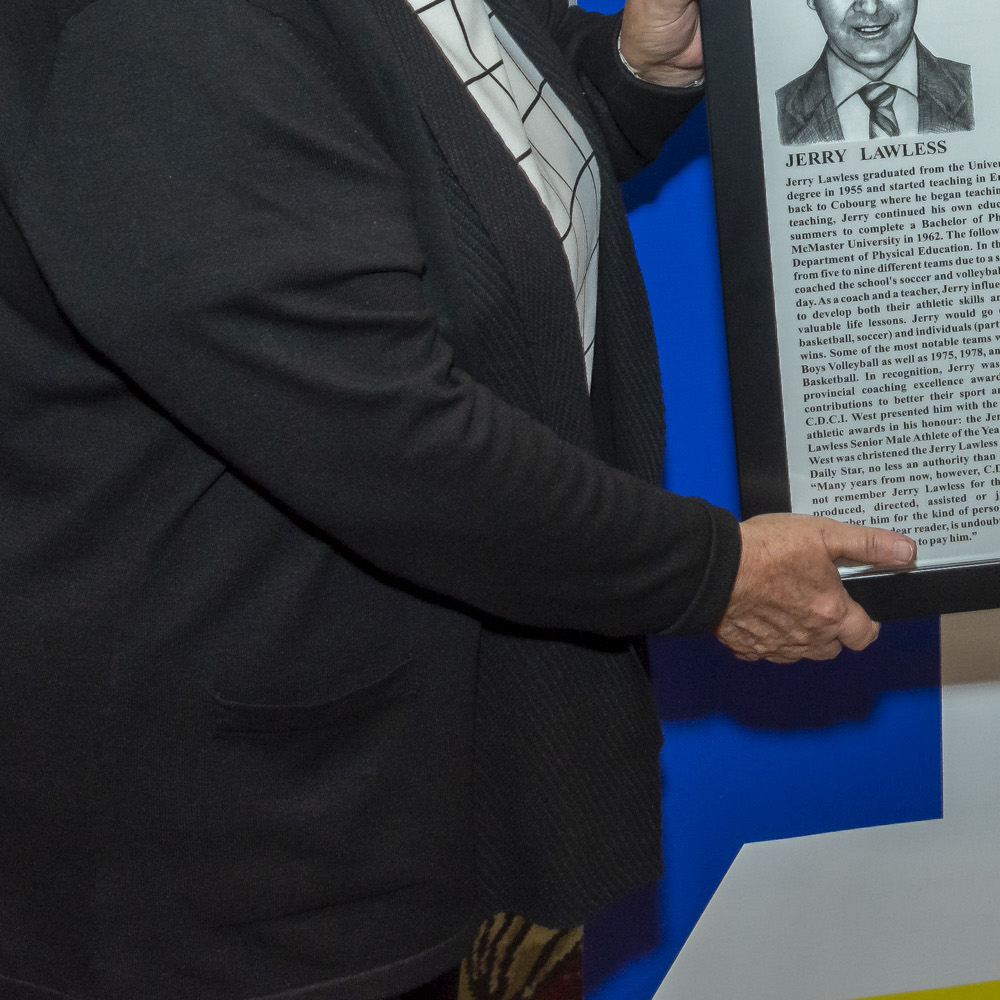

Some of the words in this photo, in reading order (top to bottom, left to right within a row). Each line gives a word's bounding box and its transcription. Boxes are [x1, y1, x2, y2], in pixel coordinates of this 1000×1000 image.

[785, 148, 847, 168] JERRY
[860, 140, 948, 161] LAWLESS
[785, 177, 813, 187] Jerry
[817, 172, 859, 184] Lawless
[862, 166, 915, 182] graduated
[919, 165, 944, 174] from
[947, 162, 964, 172] the
[787, 202, 813, 213] back
[816, 202, 827, 211] to
[830, 199, 876, 209] Cobourg
[879, 195, 911, 204] where
[914, 193, 927, 202] he
[930, 191, 961, 202] began
[789, 229, 837, 240] summers
[842, 227, 853, 235] to
[858, 222, 904, 235] complete
[921, 216, 967, 228] Bachelor
[972, 213, 983, 224] of
[792, 253, 854, 268] Department
[857, 251, 869, 261] of
[871, 247, 914, 261] Physical
[917, 243, 973, 255] Education.
[976, 241, 987, 250] In
[794, 281, 836, 294] coached
[838, 280, 854, 289] the
[857, 276, 897, 288] school's
[899, 274, 931, 284] soccer
[933, 270, 953, 281] and
[796, 312, 807, 320] to
[811, 307, 851, 319] develop
[857, 304, 880, 314] both
[885, 301, 910, 312] their
[915, 297, 953, 309] athletic
[958, 294, 984, 305] skills
[798, 333, 854, 347] basketball,
[856, 330, 892, 341] soccer)
[894, 327, 913, 338] and
[915, 322, 972, 336] individuals
[800, 364, 826, 375] Boys
[827, 357, 879, 371] Volleyball
[894, 353, 914, 364] well
[917, 354, 928, 362] as
[930, 350, 957, 361] 1975,
[960, 347, 986, 358] 1978,
[803, 386, 855, 402] provincial
[861, 382, 907, 394] coaching
[913, 377, 964, 389] excellence
[805, 413, 848, 426] C.D.C.I.
[850, 411, 877, 421] West
[880, 405, 929, 421] presented
[932, 404, 952, 413] him
[955, 400, 978, 411] with
[981, 399, 998, 408] the
[810, 481, 846, 491] “Many
[849, 478, 877, 490] years
[880, 475, 905, 484] from
[909, 473, 932, 481] now,
[935, 468, 980, 479] however,
[917, 537, 928, 546] to
[929, 536, 947, 547] pay
